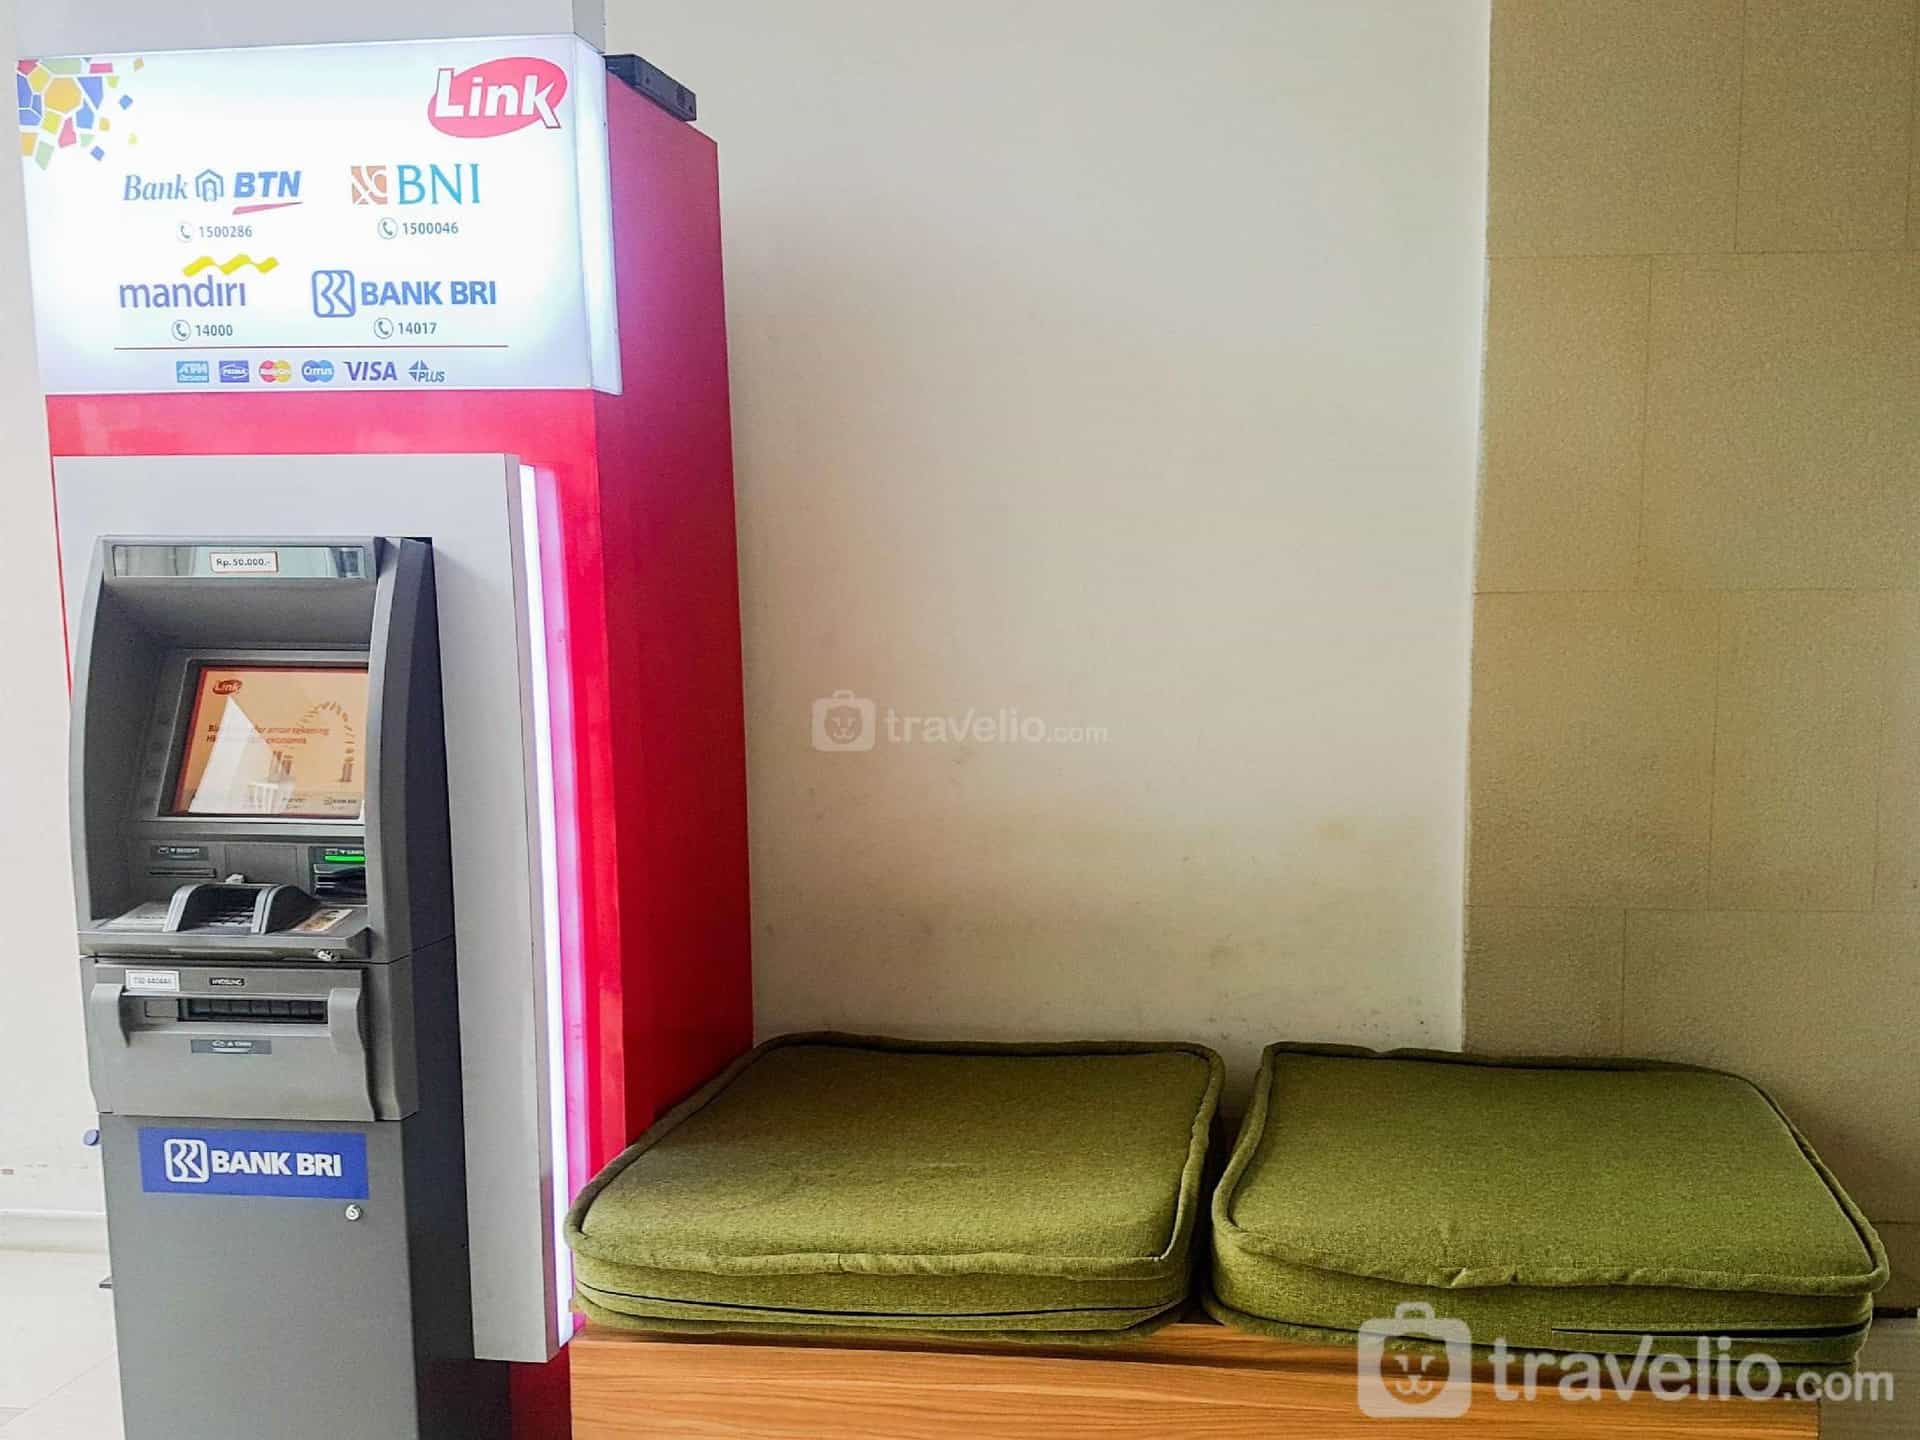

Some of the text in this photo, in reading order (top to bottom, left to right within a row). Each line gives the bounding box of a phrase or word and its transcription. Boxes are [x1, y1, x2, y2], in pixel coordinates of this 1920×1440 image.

[434, 67, 561, 129] Link
[124, 171, 302, 201] Bank BTN
[397, 163, 480, 205] BNI
[199, 225, 253, 238] 1500286
[402, 222, 459, 235] 1500046
[119, 274, 246, 308] mandiri
[360, 281, 496, 306] BANK BRI
[195, 324, 233, 337] 14000
[398, 322, 437, 335] 14017
[343, 361, 398, 381] VISA
[418, 371, 445, 382] PLUS
[211, 1150, 342, 1177] BANK BRI
